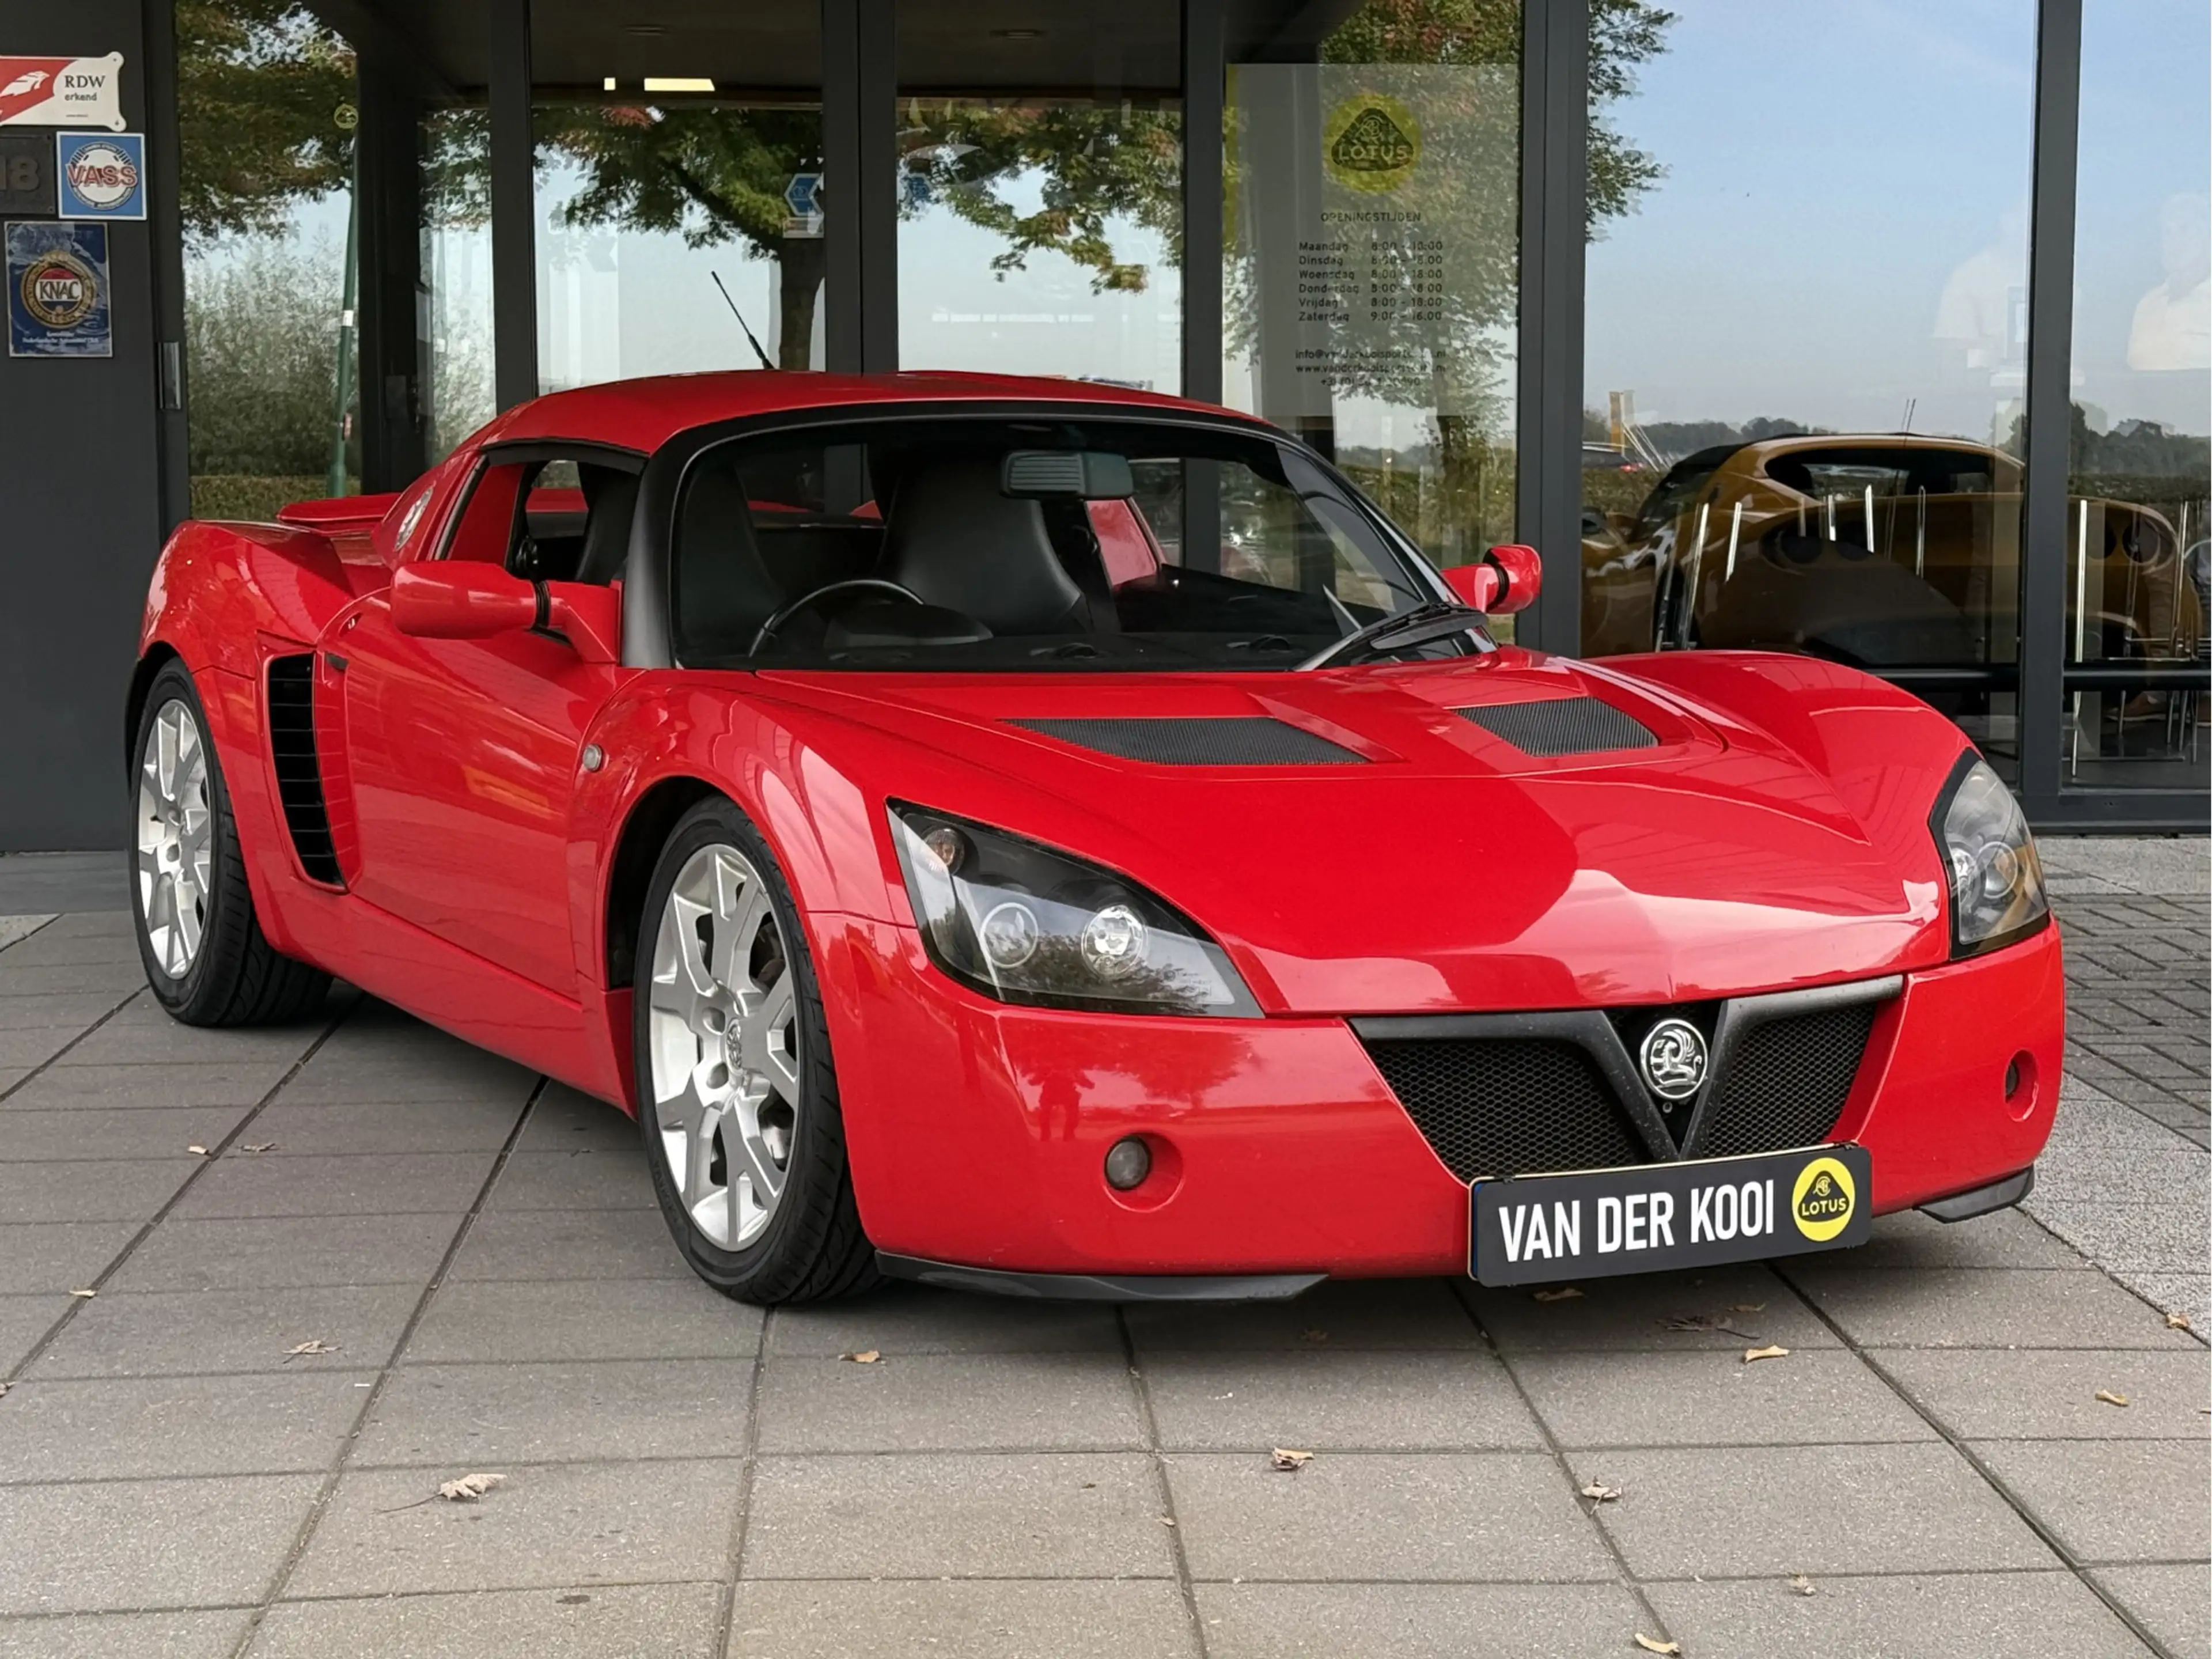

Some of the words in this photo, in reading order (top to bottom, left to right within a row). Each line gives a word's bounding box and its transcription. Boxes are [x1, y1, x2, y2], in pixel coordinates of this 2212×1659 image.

[65, 75, 105, 88] RDW
[65, 92, 97, 101] erkend
[1339, 145, 1408, 160] LOTUS
[65, 164, 138, 187] VASS
[1320, 212, 1421, 222] OPENINGSTIJDEN
[1299, 242, 1349, 252] Maandag
[1299, 256, 1343, 266] Dinsdag
[1299, 270, 1355, 280] Woensdag
[40, 281, 80, 299] KNAC
[1299, 283, 1359, 294] Donderdag
[1298, 297, 1338, 309] Vrijdag
[1298, 312, 1350, 323] Zaterdag
[1802, 1198, 1846, 1216] LOTUS
[1499, 1200, 1580, 1262] VAN
[1598, 1192, 1675, 1253] DER
[1691, 1179, 1774, 1244] KOOI
